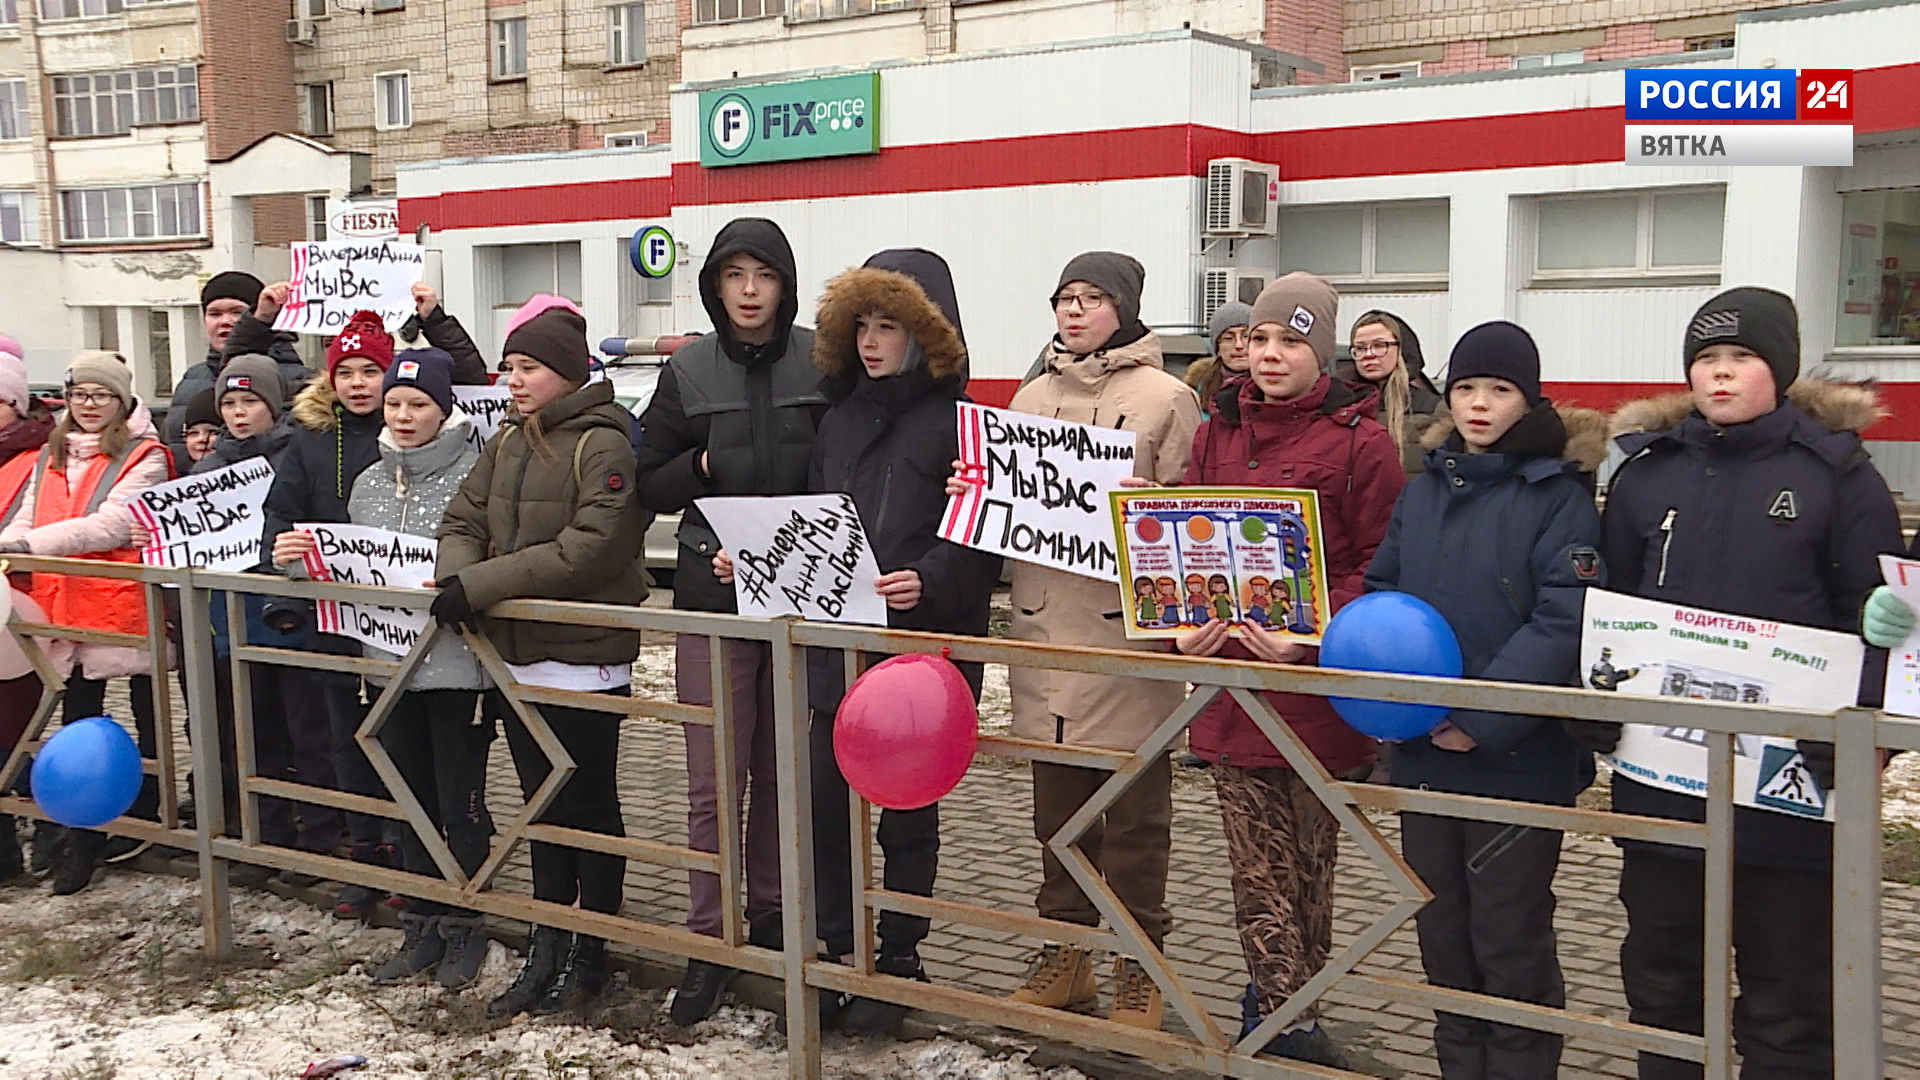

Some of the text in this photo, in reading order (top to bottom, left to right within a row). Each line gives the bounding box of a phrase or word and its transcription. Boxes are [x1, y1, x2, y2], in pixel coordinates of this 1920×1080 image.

[815, 98, 865, 123] price
[723, 109, 741, 142] F
[342, 212, 398, 230] FIESTA
[1593, 618, 1609, 630] Не
[1612, 619, 1659, 632] садись
[1669, 627, 1729, 647] пьяным
[1733, 638, 1749, 650] за
[1674, 609, 1757, 635] ВОДИТЕЛЬ
